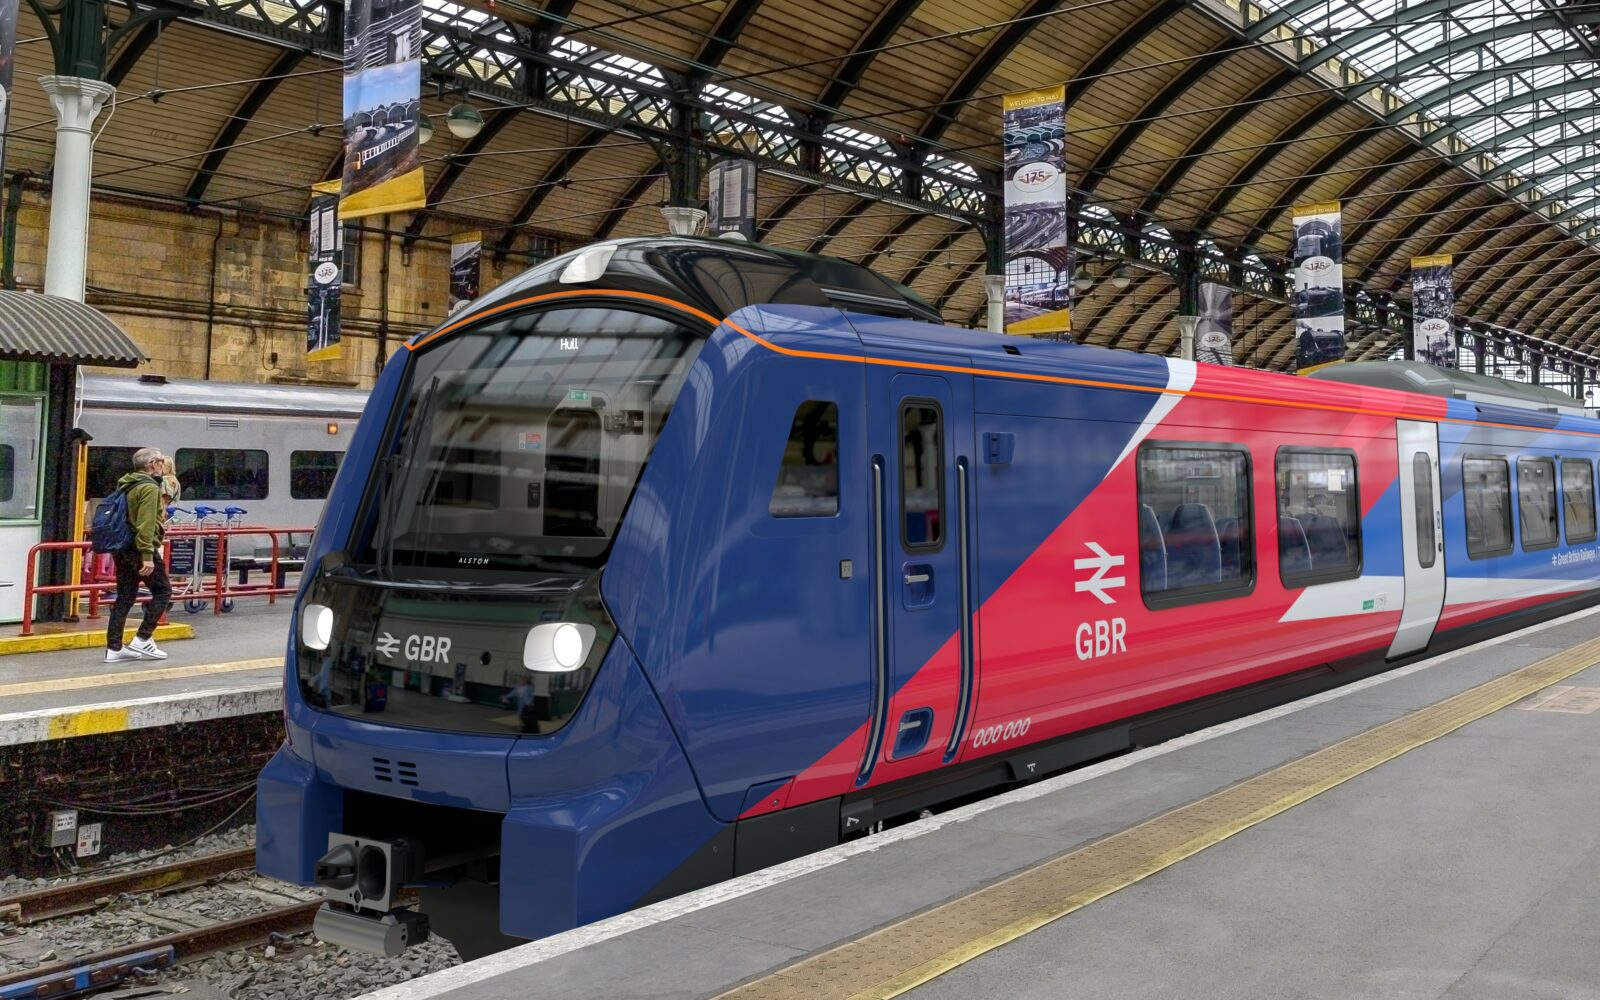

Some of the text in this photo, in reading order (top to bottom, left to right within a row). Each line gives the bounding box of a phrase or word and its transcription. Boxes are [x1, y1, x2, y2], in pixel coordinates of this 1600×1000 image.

[1010, 98, 1036, 107] WELCOME
[1025, 170, 1045, 184] 175
[560, 337, 579, 351] Hull
[1557, 552, 1568, 566] Great
[1568, 549, 1580, 563] British
[1075, 617, 1127, 661] GBR
[404, 634, 452, 664] GBR
[973, 716, 1032, 749] 000 000
